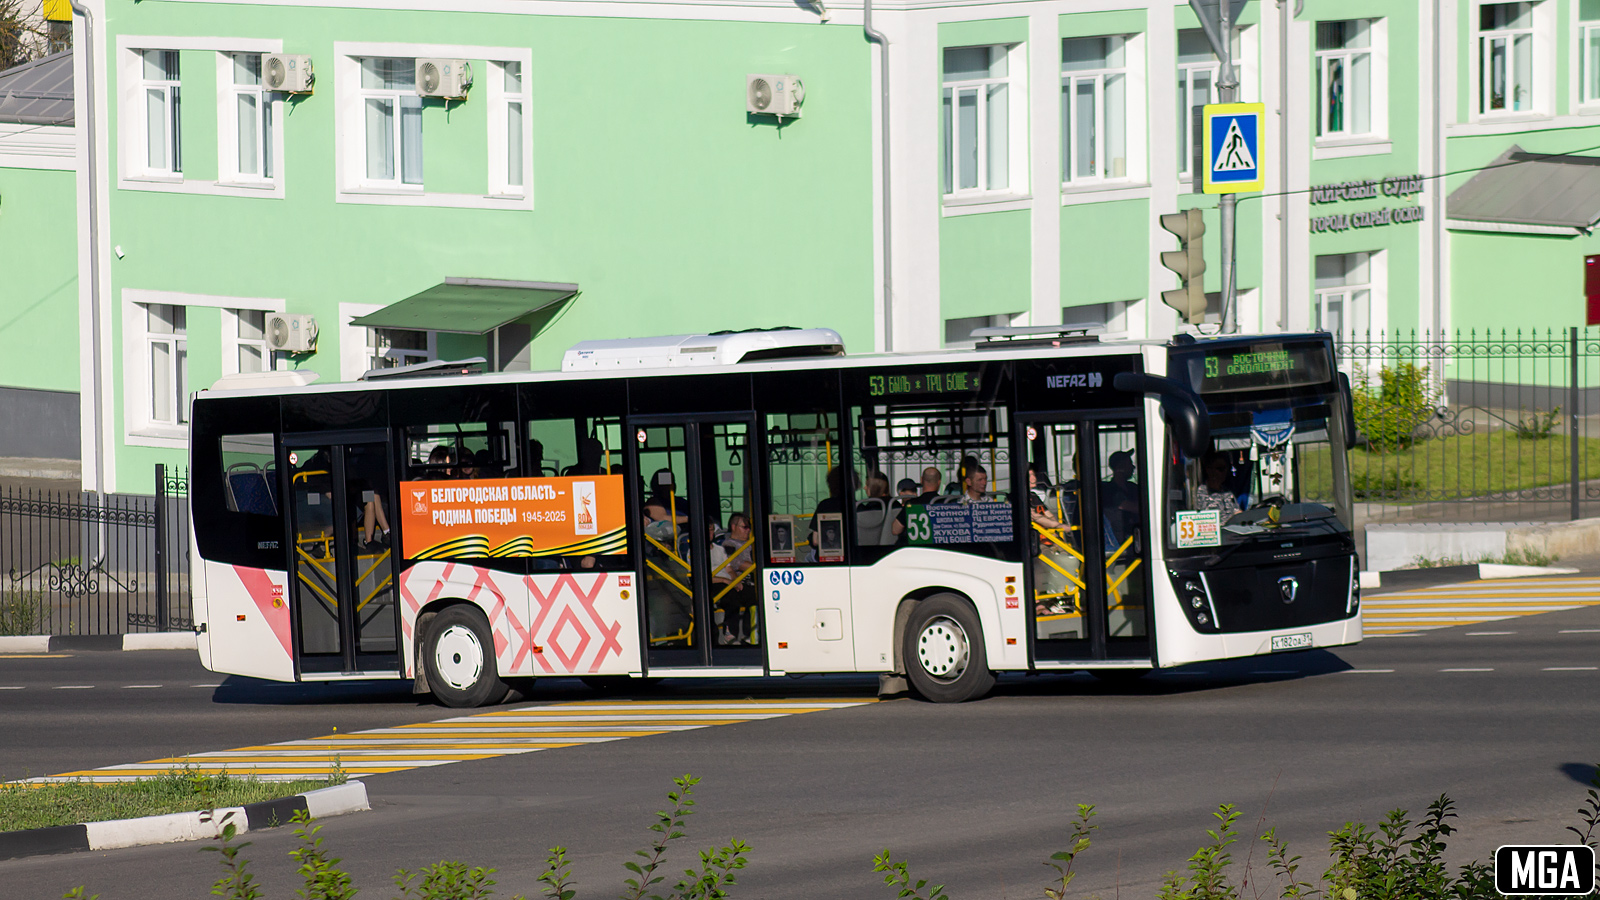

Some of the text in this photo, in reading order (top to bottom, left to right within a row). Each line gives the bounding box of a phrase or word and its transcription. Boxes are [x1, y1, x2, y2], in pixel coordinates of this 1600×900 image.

[1310, 174, 1424, 204] МИРОВЫЕ СУДЬИ
[1310, 214, 1349, 232] ГОРОДА
[1352, 207, 1390, 227] СТАРЫЙ
[1205, 357, 1219, 378] 53
[869, 375, 885, 396] 53
[925, 374, 942, 393] ТРЦ
[1046, 374, 1087, 389] NEFAZ
[431, 486, 509, 504] БЕЛГОРОДСКАЯ
[511, 485, 556, 501] ОБЛАСТЬ
[432, 508, 566, 527] РОДИНА ПОБЕДЫ 1945-2025
[908, 513, 931, 541] 53
[933, 536, 949, 544] ТРЦ
[1180, 521, 1195, 539] 53
